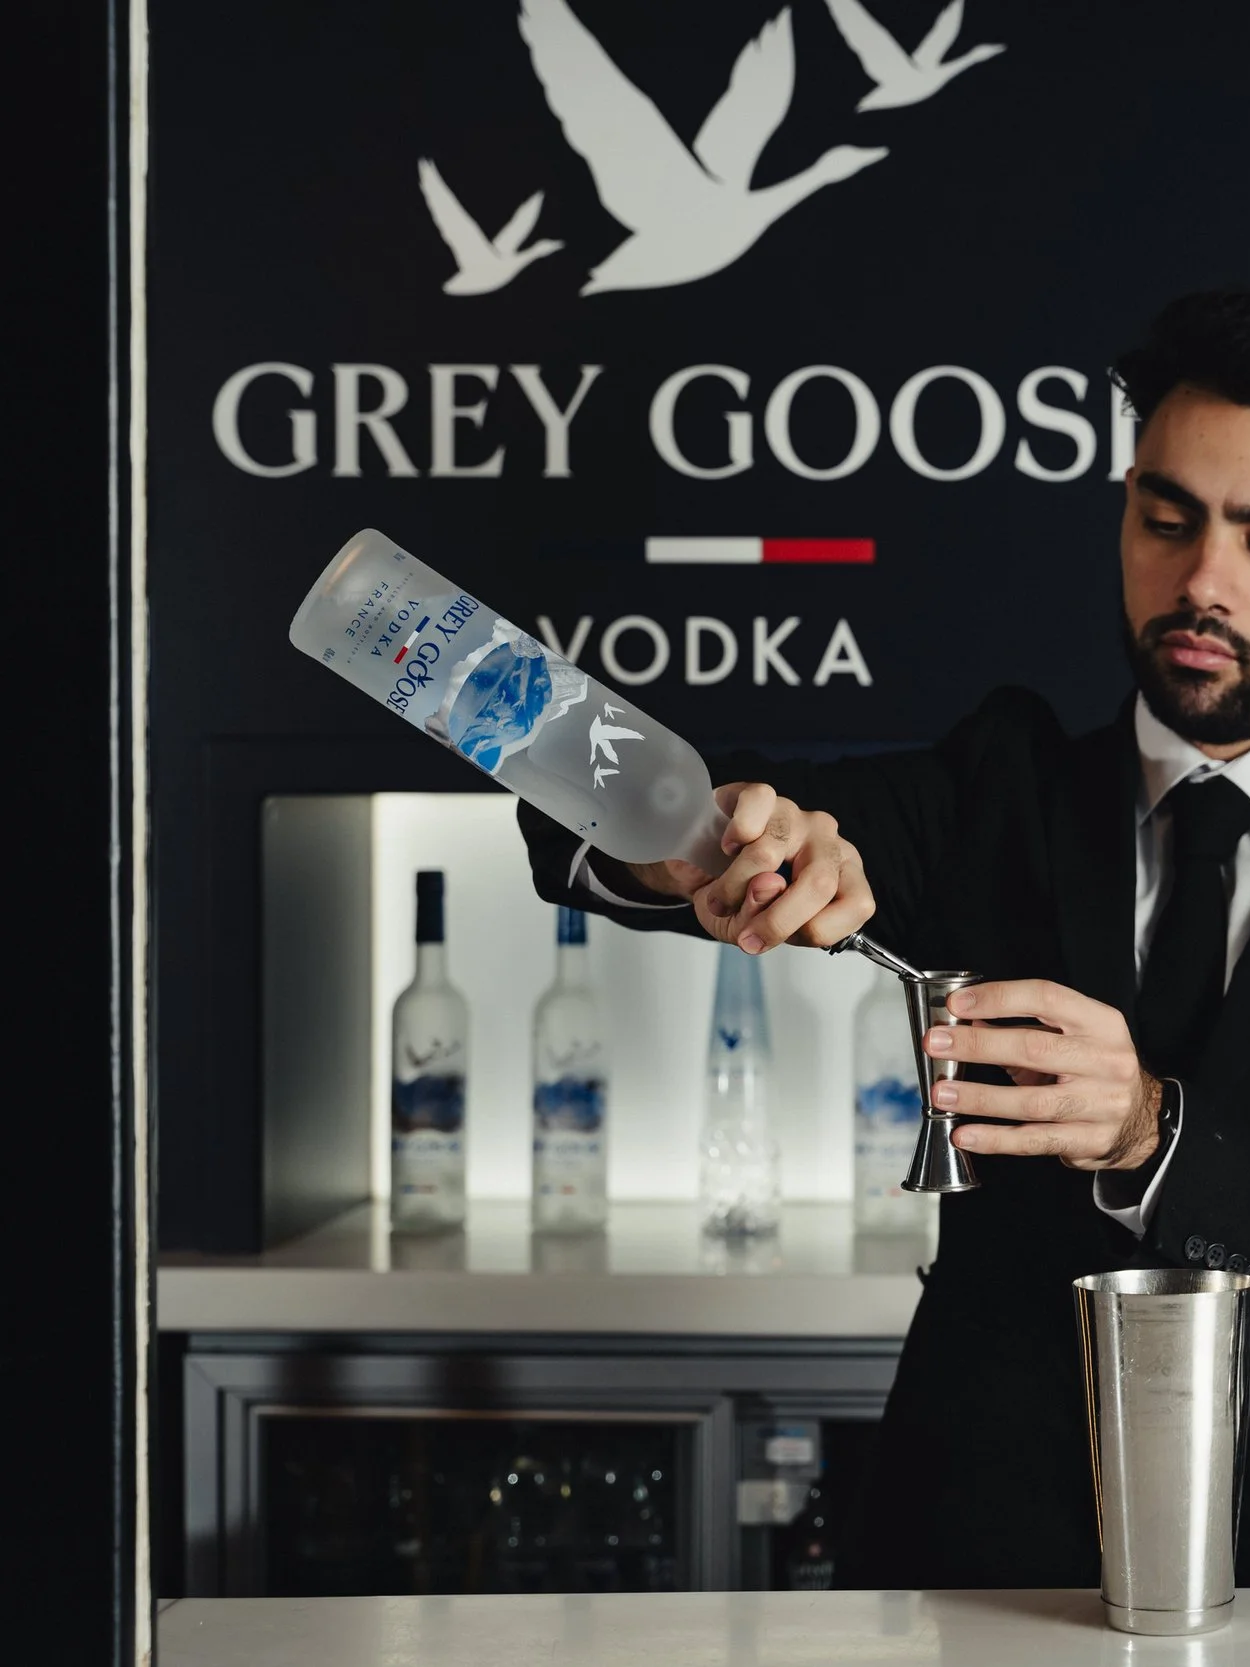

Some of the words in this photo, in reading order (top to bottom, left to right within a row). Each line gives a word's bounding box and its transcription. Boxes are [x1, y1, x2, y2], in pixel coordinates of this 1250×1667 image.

[211, 361, 605, 479] GREY
[345, 581, 389, 637] FRANCE
[370, 599, 420, 657] VODKA
[434, 595, 480, 643] GREY
[386, 642, 441, 714] GOOSE
[536, 614, 874, 688] VODKA
